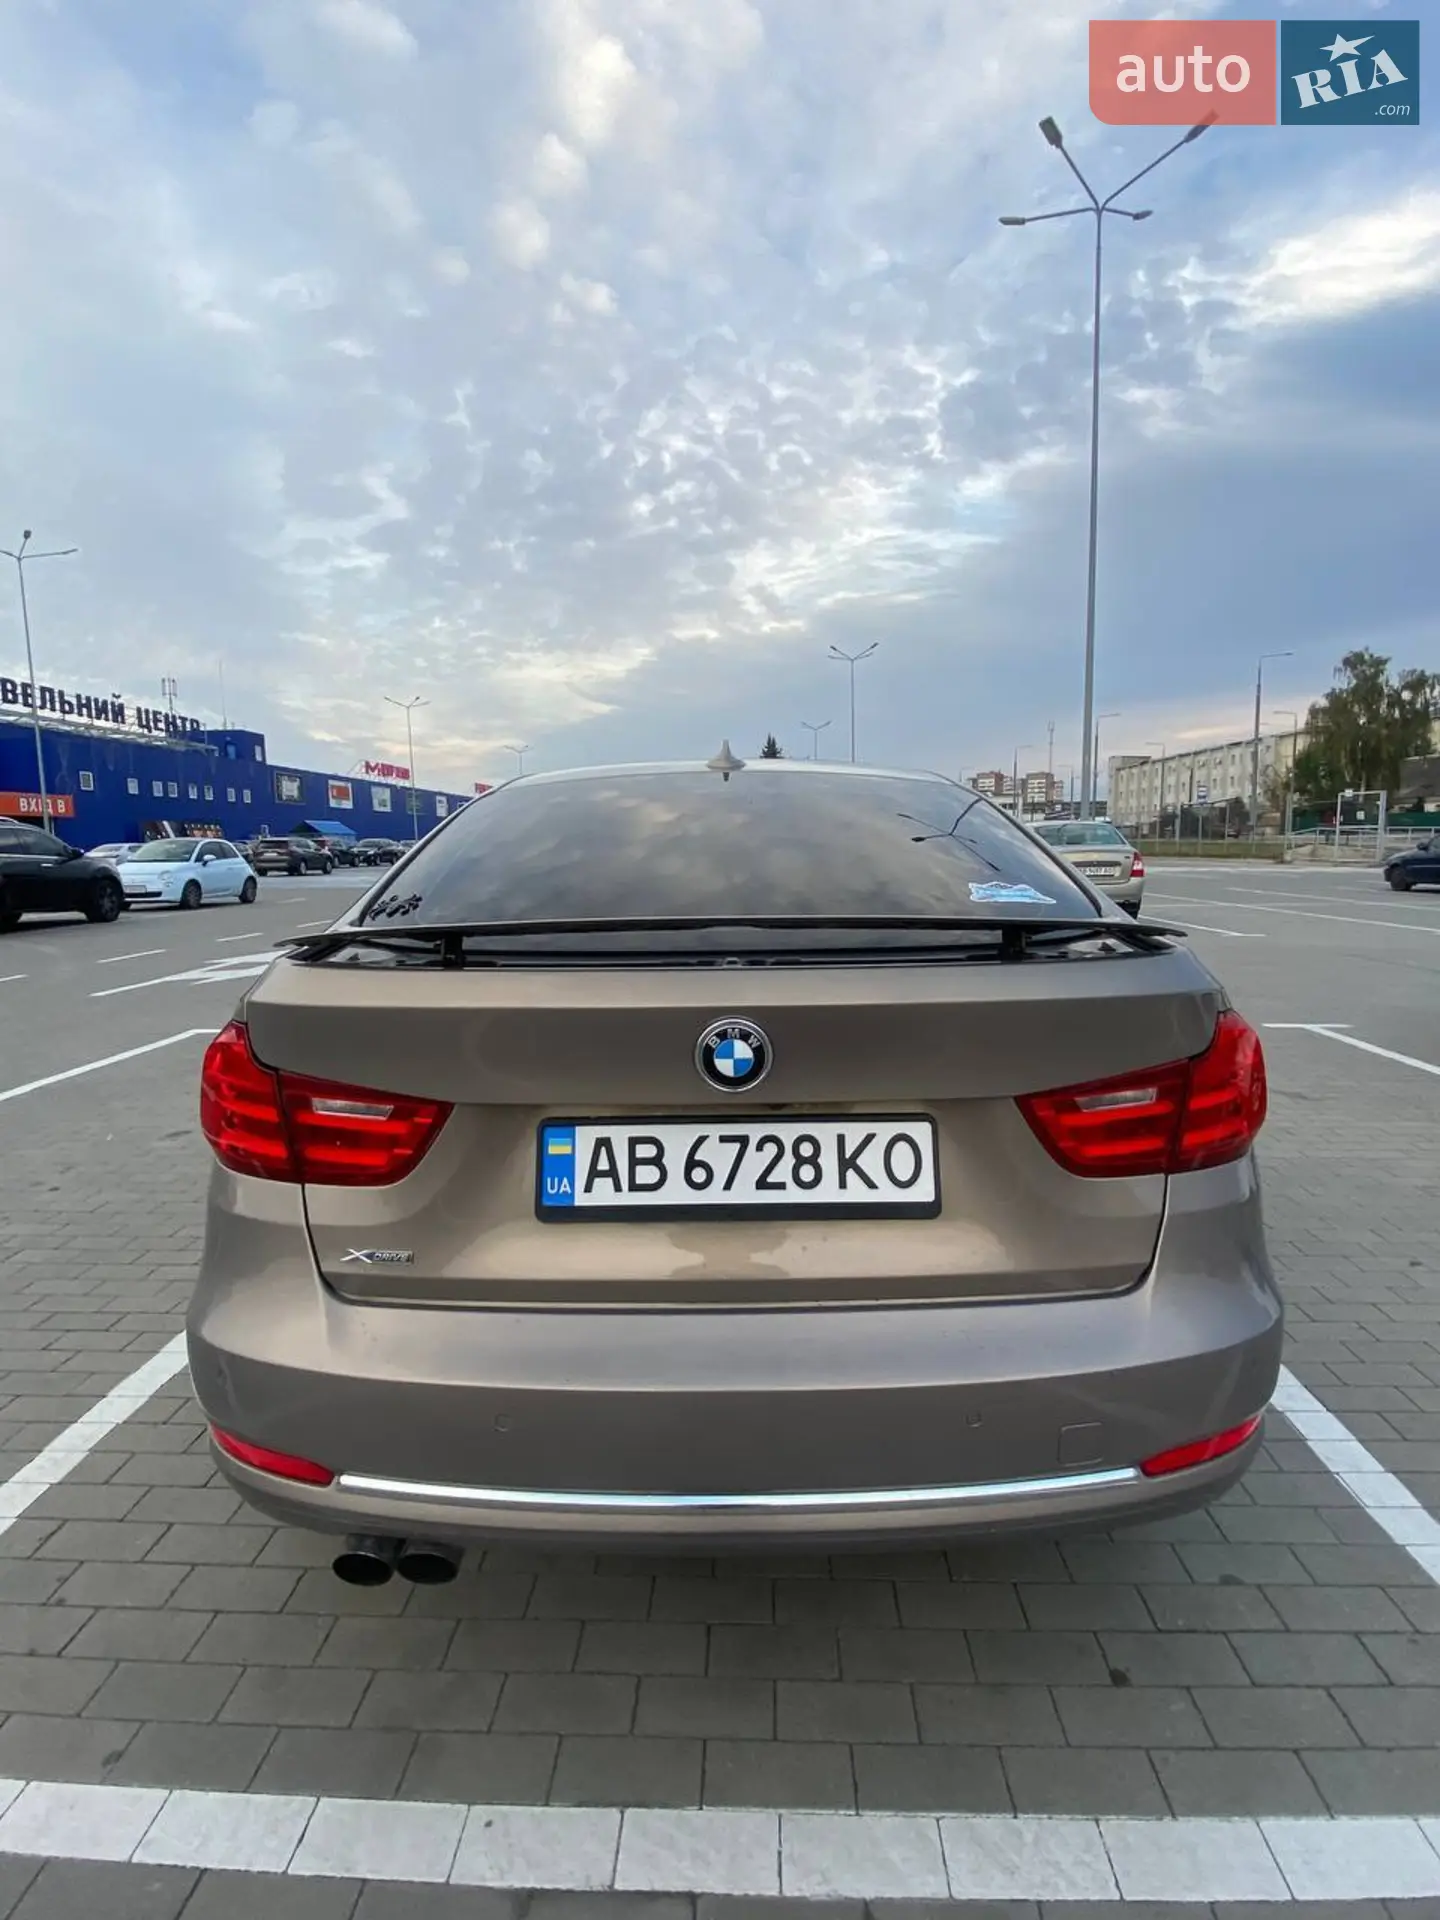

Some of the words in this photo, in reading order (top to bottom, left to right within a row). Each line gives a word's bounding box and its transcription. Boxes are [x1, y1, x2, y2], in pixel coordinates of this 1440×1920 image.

[707, 1027, 761, 1049] BMW
[583, 1135, 668, 1193] AB
[683, 1133, 823, 1191] 6728
[836, 1132, 923, 1190] KO
[546, 1176, 572, 1194] UA
